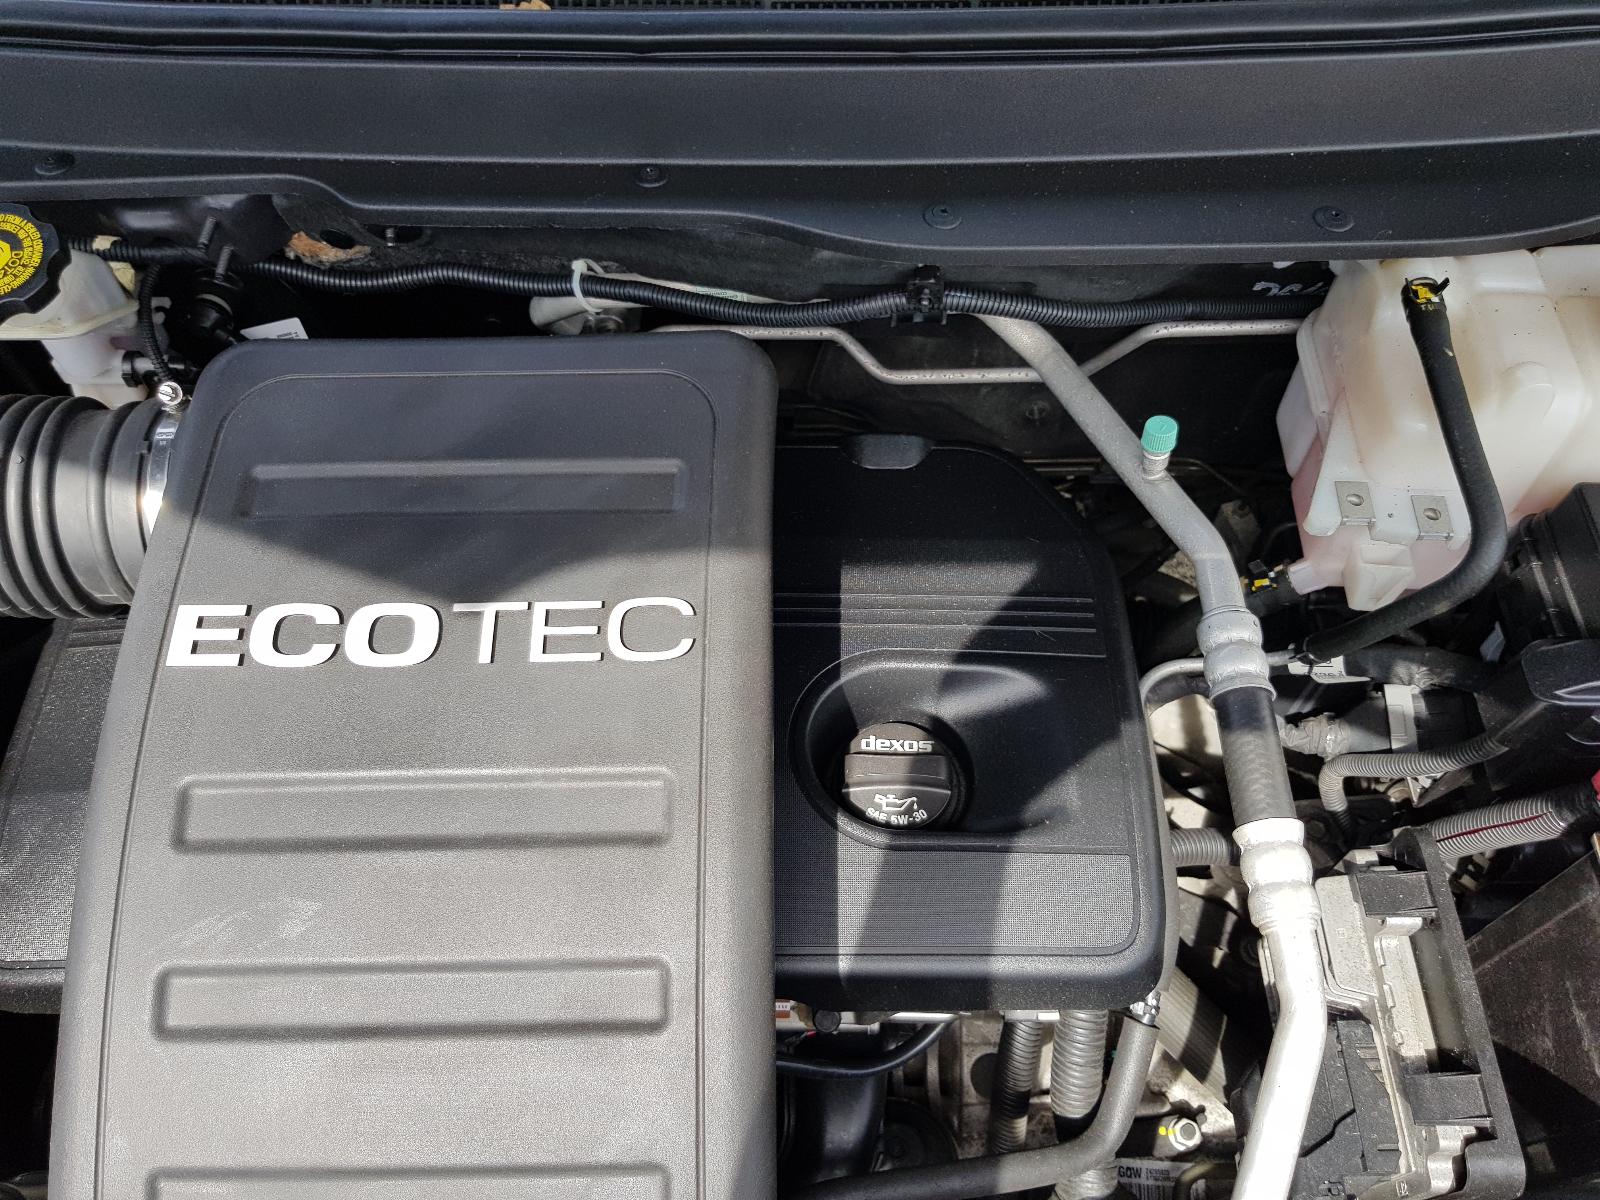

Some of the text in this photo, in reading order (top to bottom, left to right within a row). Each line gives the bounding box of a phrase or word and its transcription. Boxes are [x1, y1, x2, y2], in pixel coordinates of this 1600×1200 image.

[4, 251, 23, 275] DOT
[166, 596, 697, 668] ECOTEC
[860, 735, 935, 752] dexos
[866, 807, 888, 824] SAE
